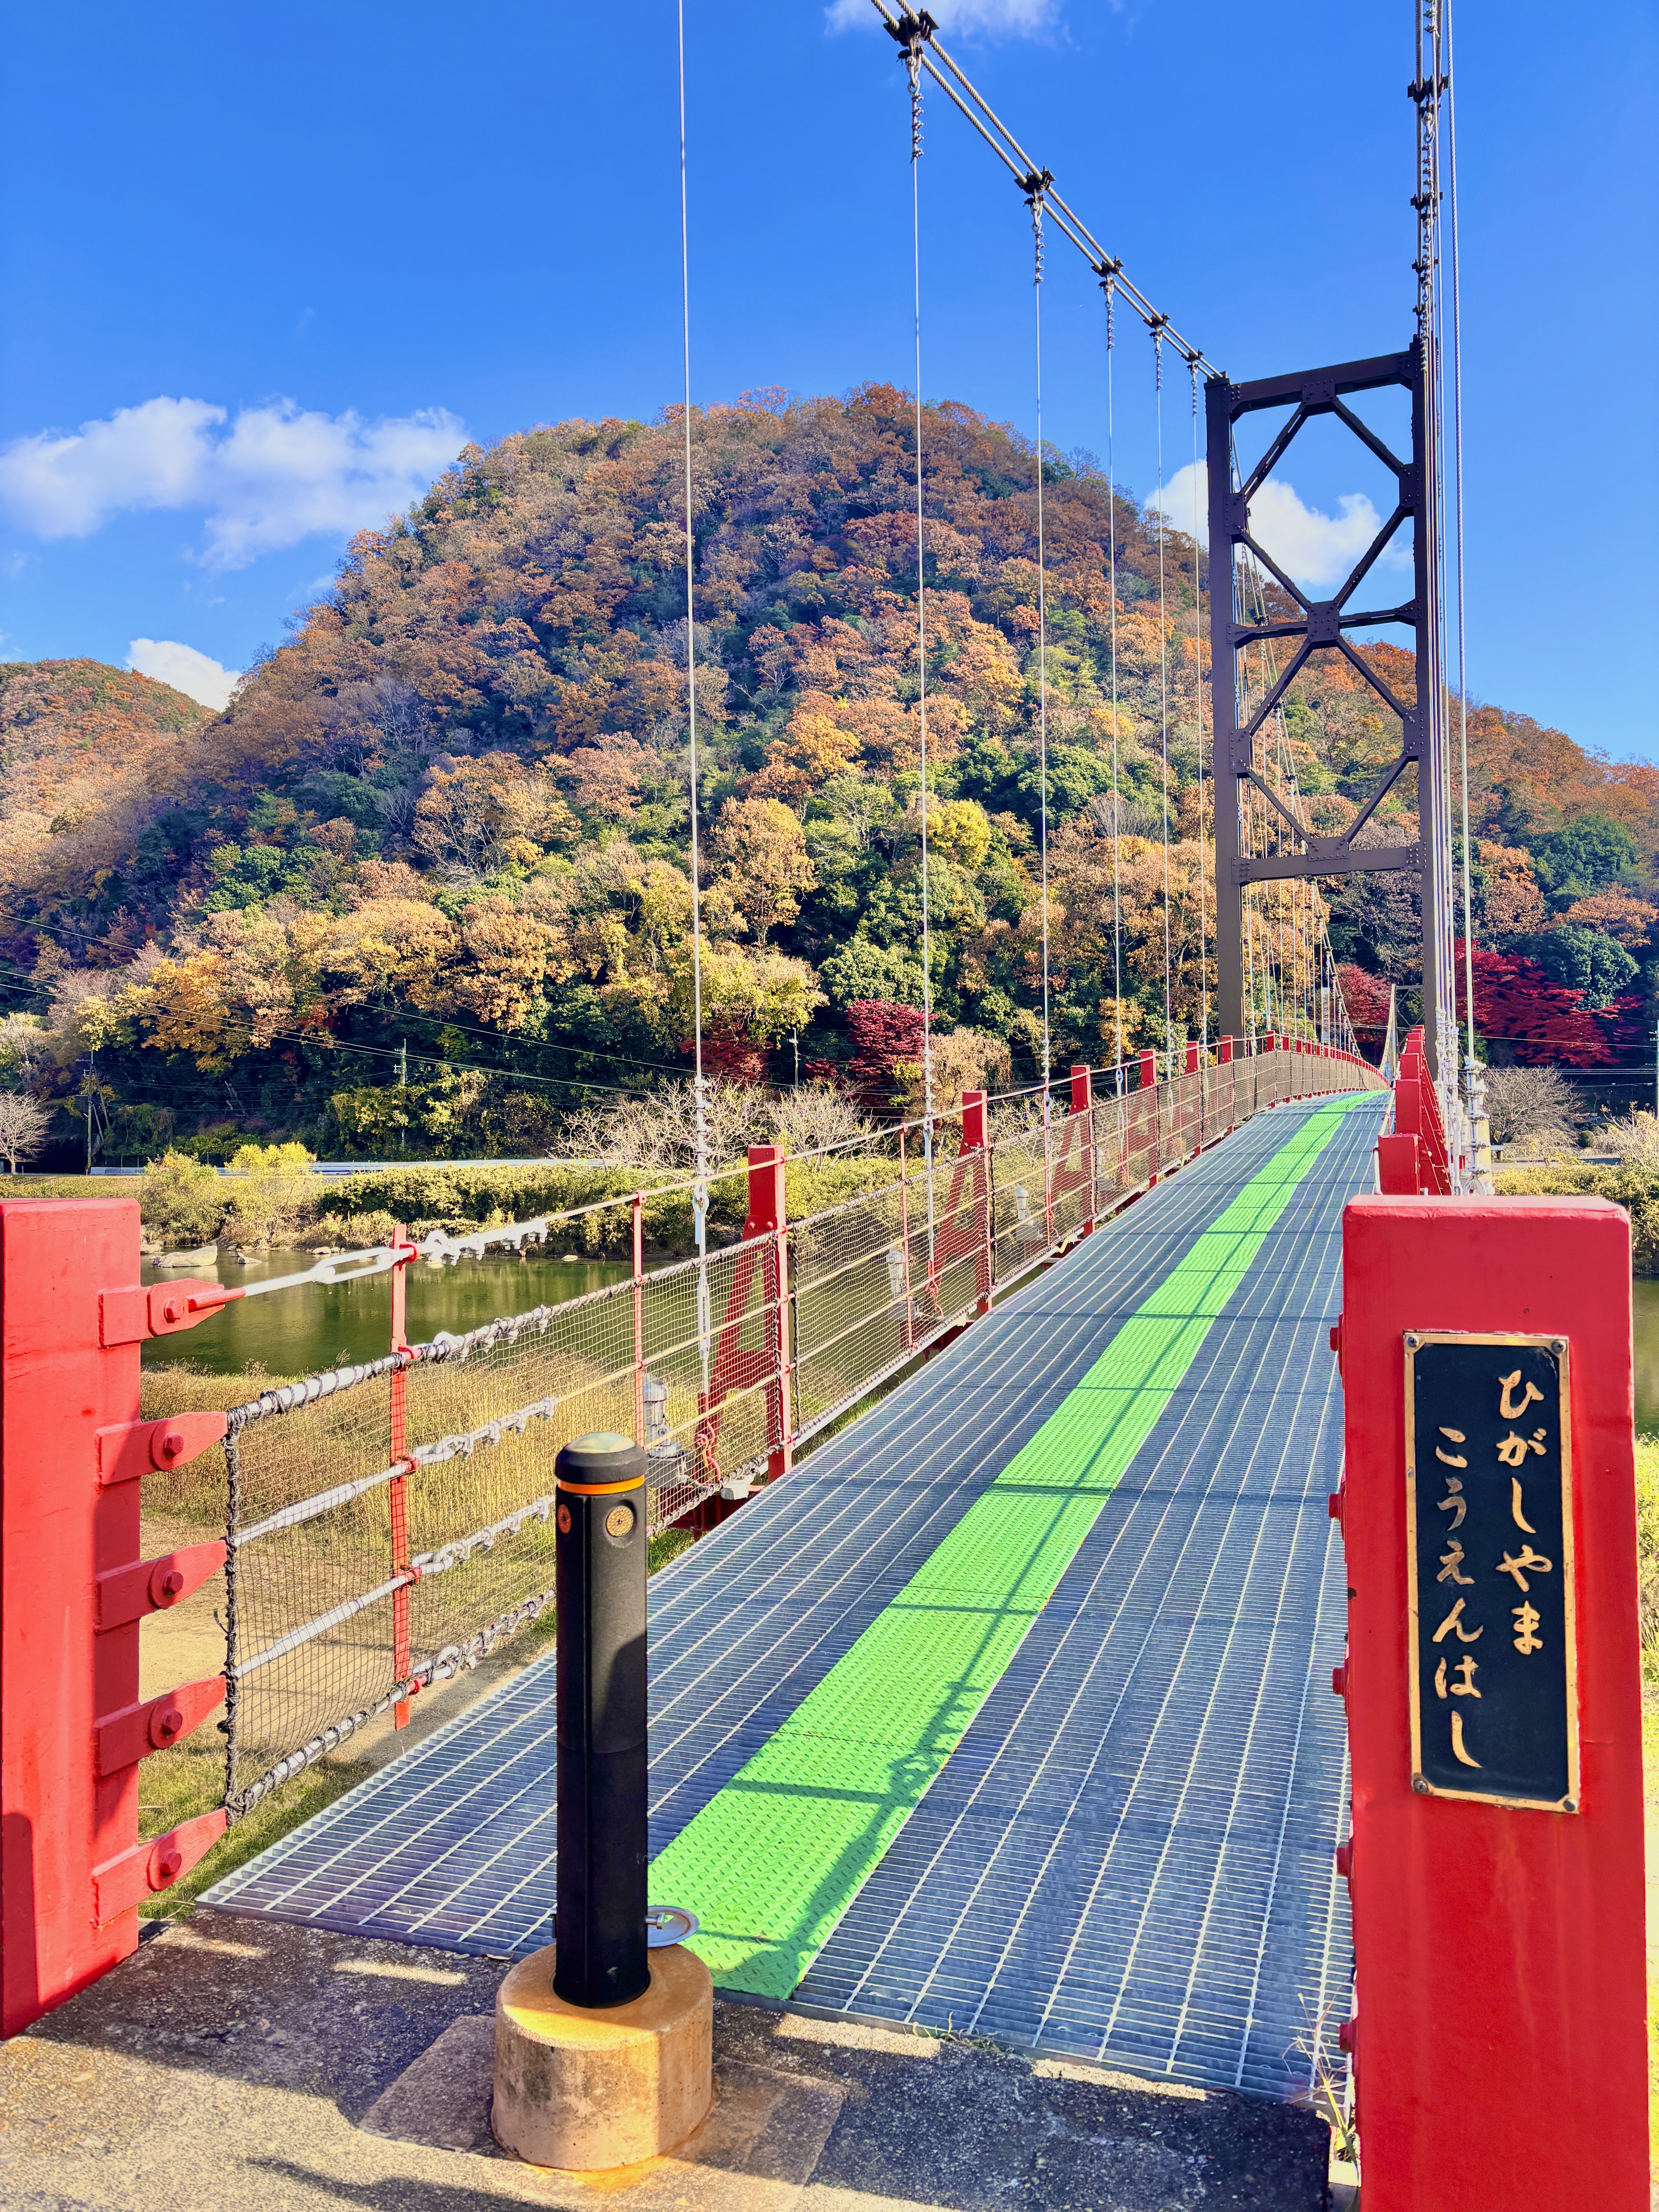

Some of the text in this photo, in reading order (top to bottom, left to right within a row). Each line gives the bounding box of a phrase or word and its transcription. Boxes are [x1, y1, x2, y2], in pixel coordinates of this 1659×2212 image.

[1432, 1426, 1483, 1768] こうえんはし
[1496, 1369, 1553, 1655] ひがしやま
